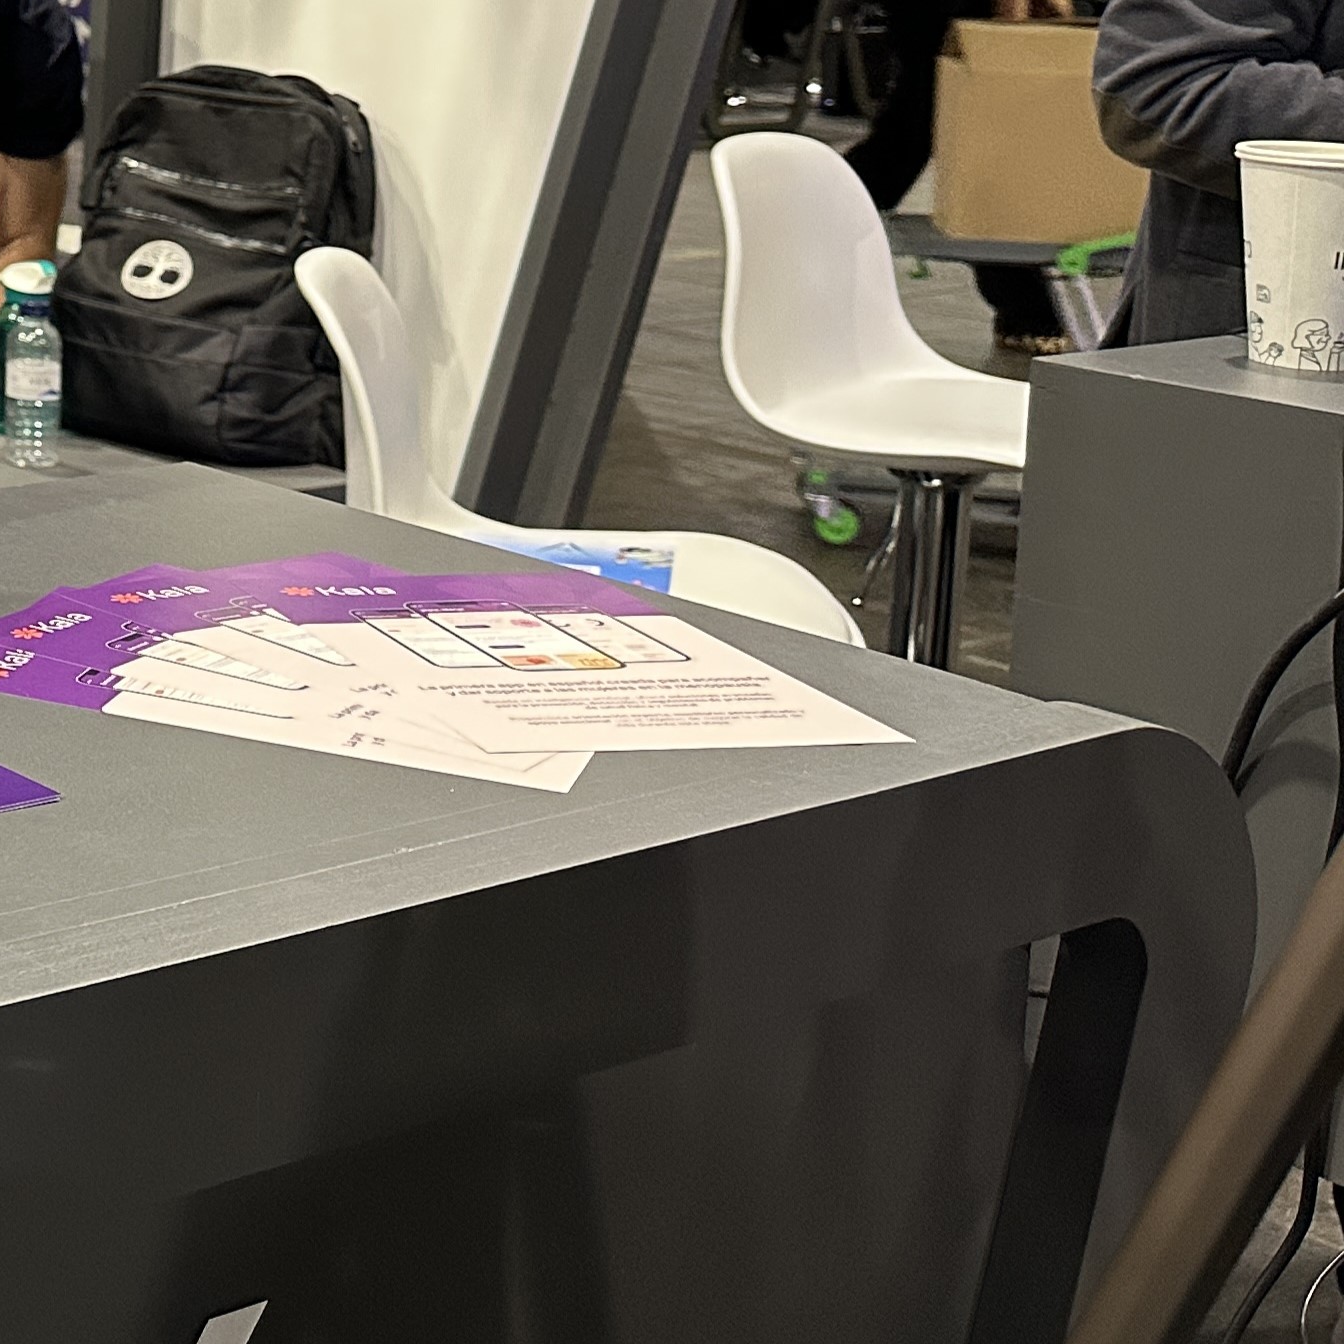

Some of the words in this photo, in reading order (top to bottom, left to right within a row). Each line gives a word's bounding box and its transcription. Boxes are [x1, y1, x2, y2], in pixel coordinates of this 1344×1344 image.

[136, 582, 211, 602] Kala
[314, 583, 398, 598] Kala
[33, 611, 93, 634] Kala
